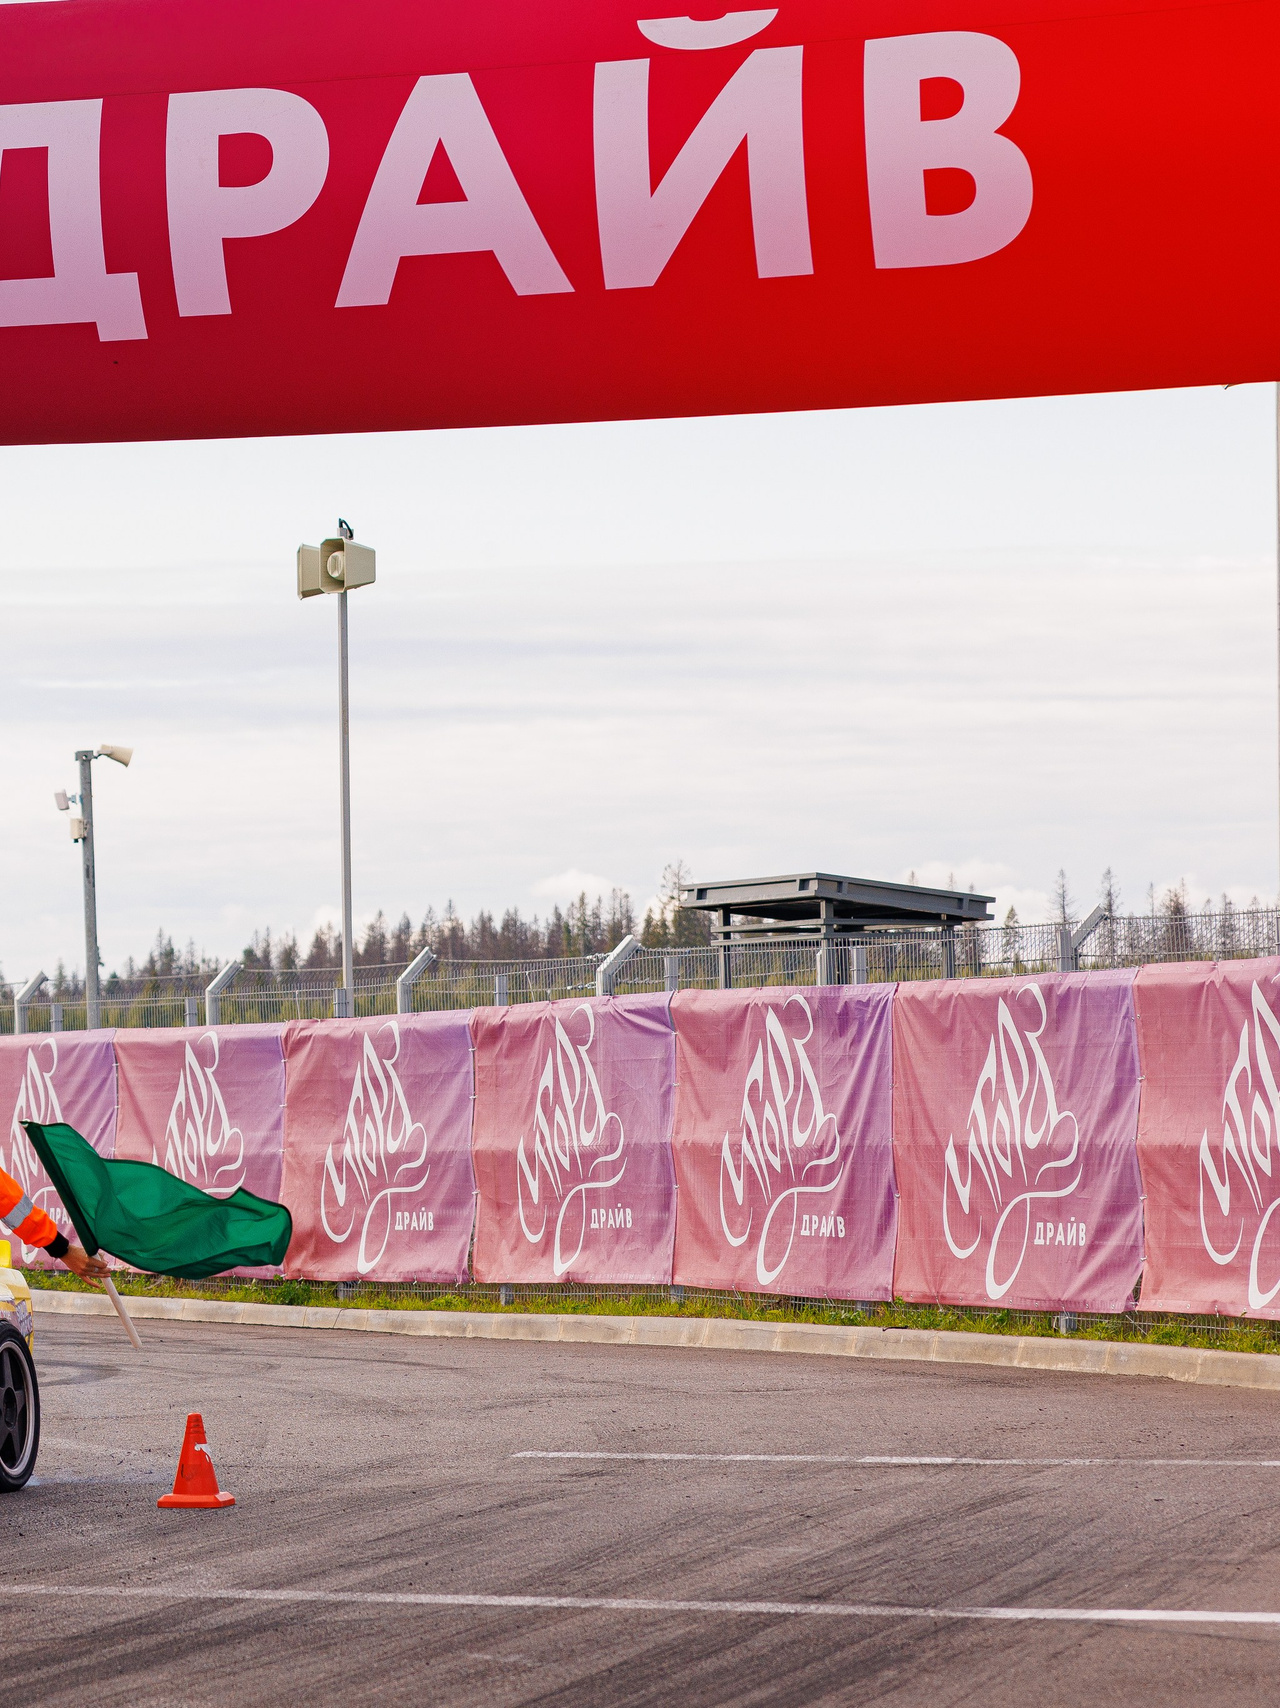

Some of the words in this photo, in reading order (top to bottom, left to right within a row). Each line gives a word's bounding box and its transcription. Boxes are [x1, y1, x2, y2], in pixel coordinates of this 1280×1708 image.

[394, 1203, 435, 1232] ДРАЙВ
[590, 1202, 633, 1230] ДРАЙВ
[800, 1211, 846, 1239] ДРАЙВ
[1034, 1217, 1087, 1248] ДРАЙВ
